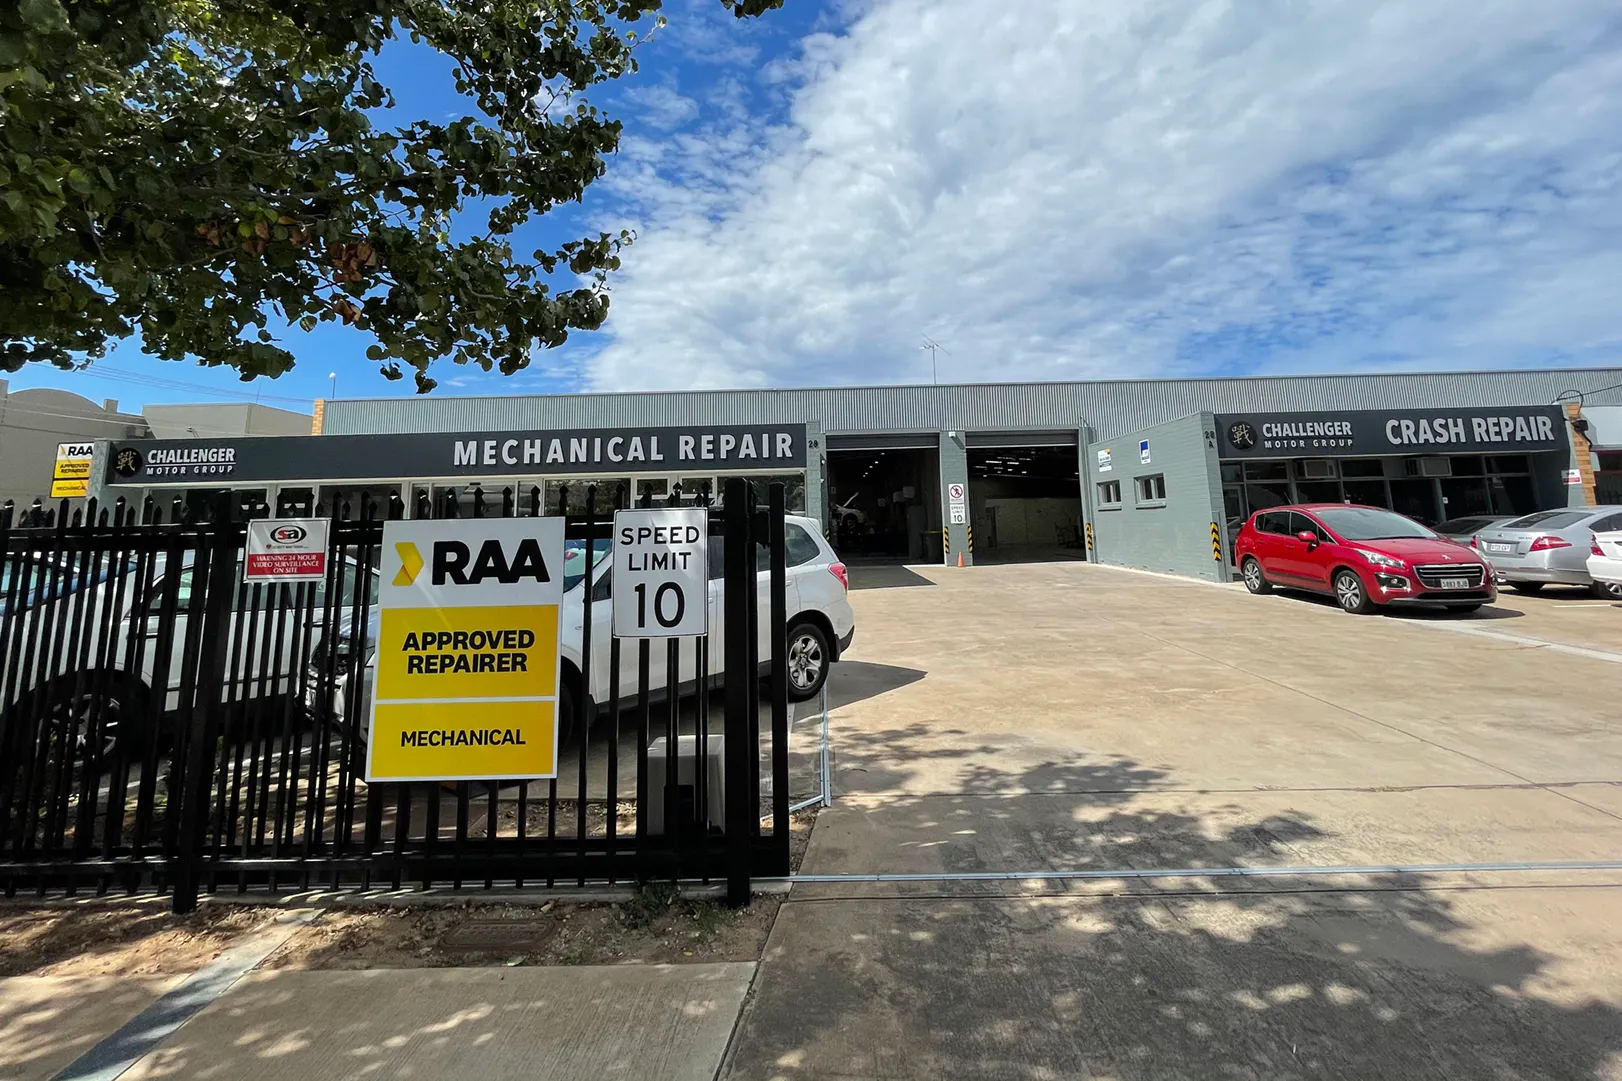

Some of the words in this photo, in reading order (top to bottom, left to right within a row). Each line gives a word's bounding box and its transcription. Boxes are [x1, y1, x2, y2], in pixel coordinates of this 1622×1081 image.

[1262, 421, 1352, 437] CHALLENGER
[1385, 418, 1466, 445] CRASH
[1471, 415, 1555, 442] REPAIR
[68, 445, 93, 456] RAA
[454, 436, 664, 466] MECHANICAL
[679, 433, 793, 460] REPAIR
[808, 439, 819, 449] 28
[1208, 440, 1215, 449] A
[1264, 440, 1305, 448] MOTOR
[1313, 439, 1353, 447] GROUP
[147, 448, 235, 463] CHALLENGER
[146, 466, 186, 475] MOTOR
[193, 465, 233, 474] GROUP
[953, 514, 963, 522] 10
[620, 526, 700, 546] SPEED
[432, 538, 551, 586] RAA
[628, 552, 692, 572] LIMIT
[634, 581, 685, 629] 10
[402, 629, 535, 652] APPROVED
[407, 652, 527, 675] REPAIRER
[400, 728, 526, 748] MECHANICAL
